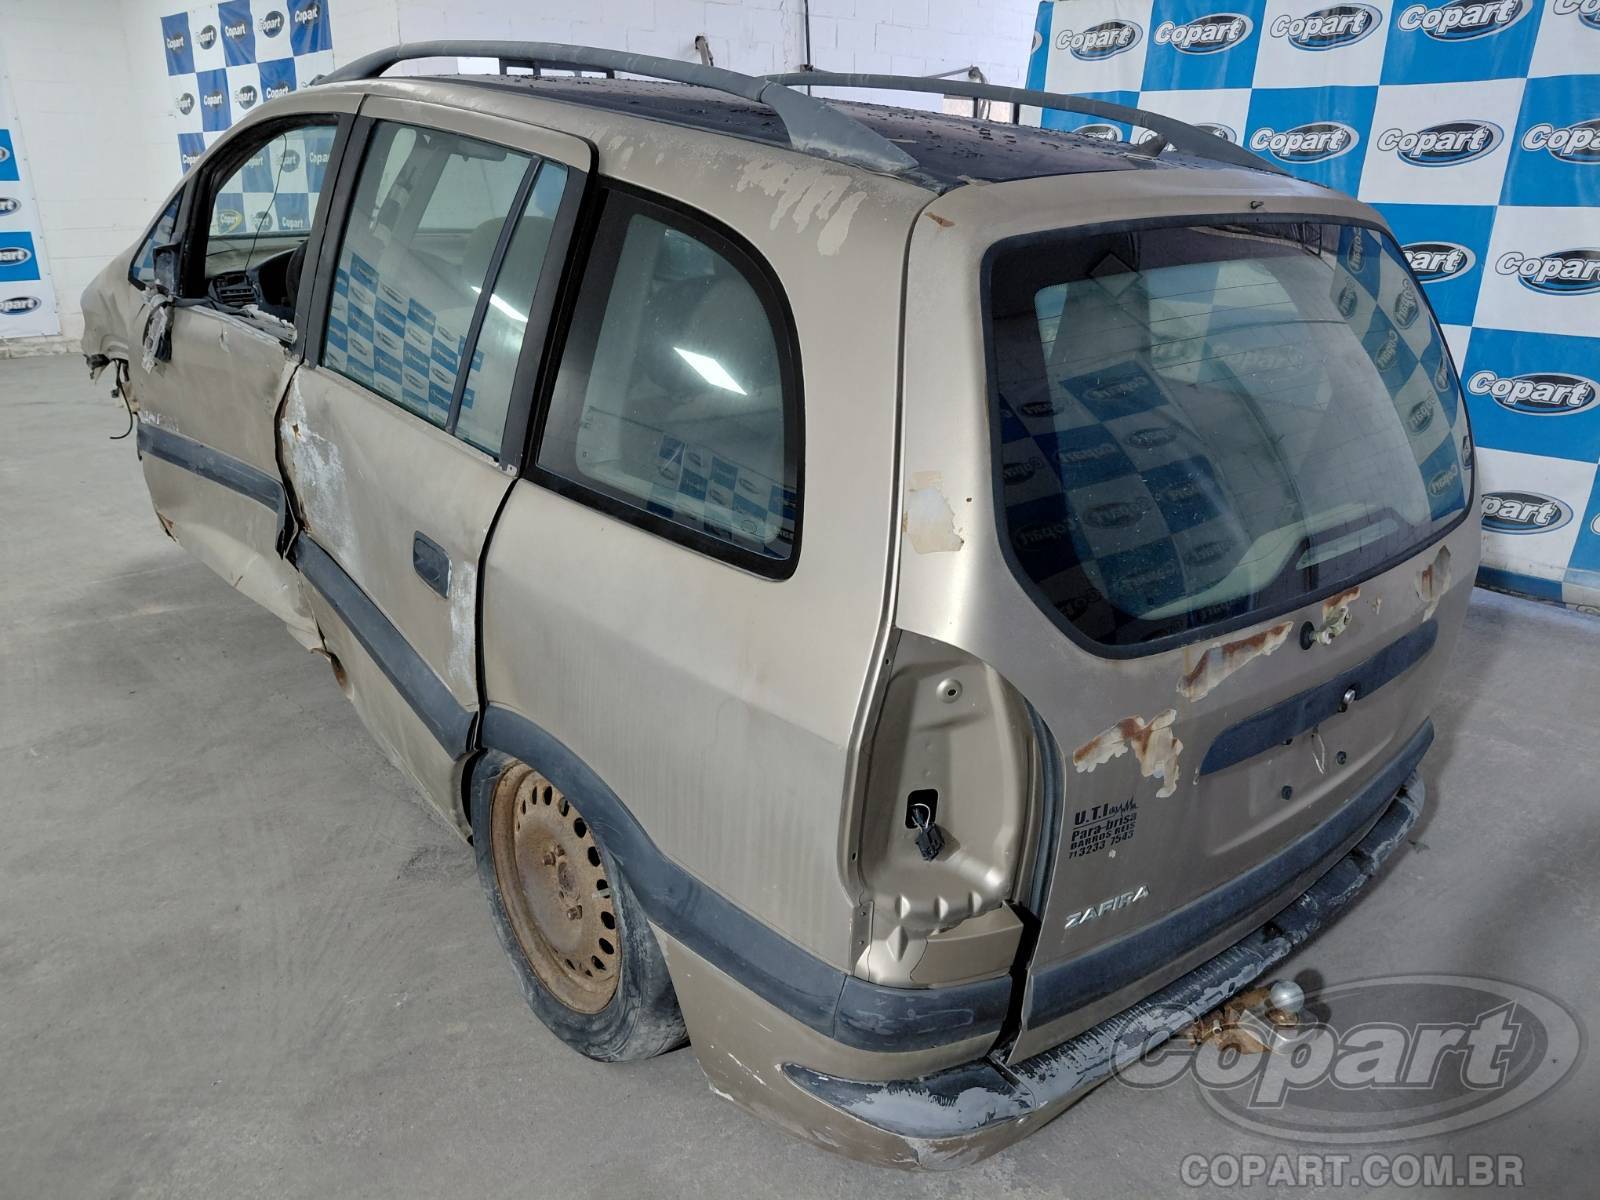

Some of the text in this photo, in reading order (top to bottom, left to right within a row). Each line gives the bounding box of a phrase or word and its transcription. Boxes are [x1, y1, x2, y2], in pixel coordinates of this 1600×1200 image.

[1155, 17, 1244, 48] Copart
[1270, 9, 1369, 42] Copart
[1399, 0, 1516, 35] Copart
[1056, 25, 1132, 53] Copart
[1250, 128, 1346, 156] Copart
[1377, 126, 1489, 157] Copart
[1495, 252, 1600, 283] Copar
[1467, 370, 1590, 405] Copart
[1064, 884, 1150, 929] ZAFIRA
